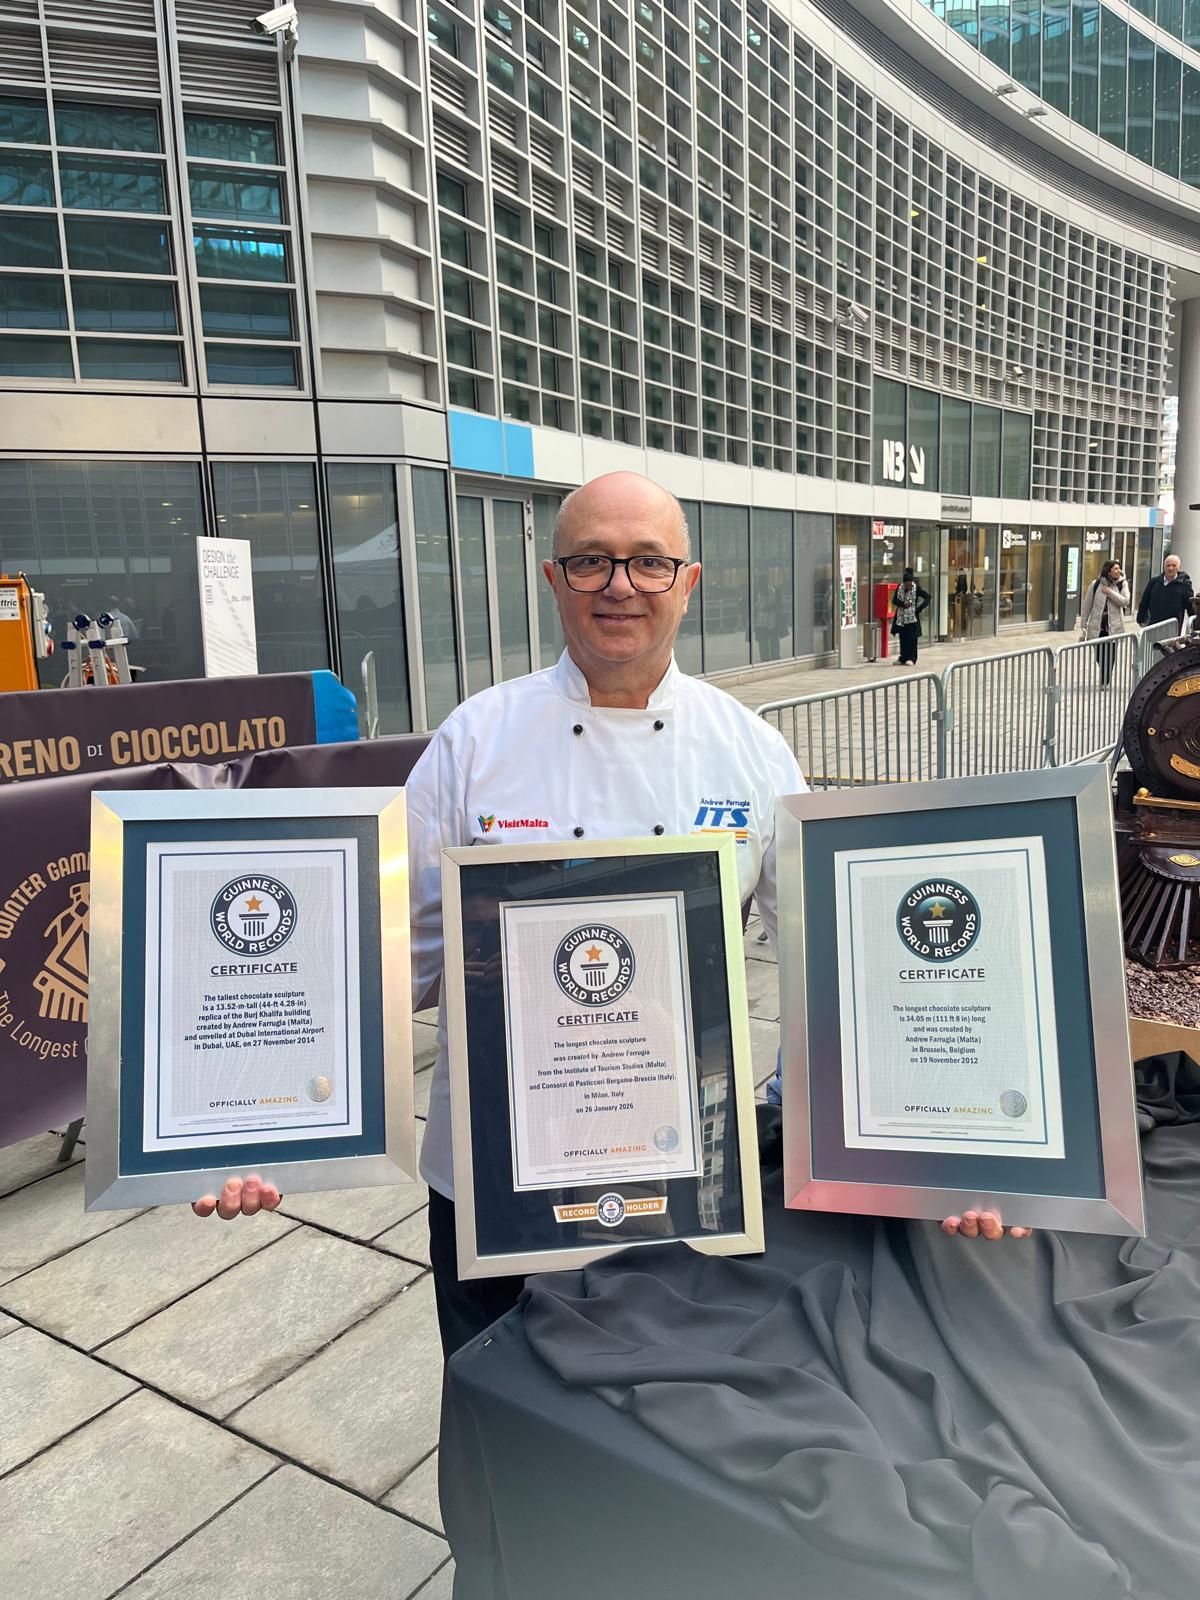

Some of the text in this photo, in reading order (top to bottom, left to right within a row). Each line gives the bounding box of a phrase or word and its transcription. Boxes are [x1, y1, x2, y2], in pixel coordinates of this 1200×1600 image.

[883, 439, 905, 482] N3
[203, 550, 226, 563] DESIGN
[204, 565, 240, 579] CHALLENGE
[87, 744, 103, 757] DI
[110, 715, 286, 765] CIOCCOLATO
[701, 798, 750, 807] Andrew Farrugia
[694, 806, 750, 827] ITS
[497, 819, 549, 829] VisitMalta
[46, 852, 91, 881] GAM
[223, 879, 286, 902] GUINNESS
[907, 883, 969, 907] GUINNESS
[215, 909, 292, 953] WORLD RECORDS
[901, 913, 976, 958] WORLD RECORDS
[564, 928, 623, 952] GUINNESS
[210, 962, 298, 975] CERTIFICATE
[899, 968, 985, 981] CERTIFICATE
[558, 957, 631, 1003] WORLD RECORDS
[217, 993, 239, 1001] tallest
[240, 992, 273, 1000] chocolate
[274, 991, 305, 1000] sculpture
[259, 1001, 279, 1009] (44-ft
[279, 999, 307, 1008] 4.28-in)
[905, 1005, 928, 1014] longest
[960, 1005, 991, 1014] sculpture
[198, 1013, 222, 1022] replica
[231, 1011, 243, 1019] the
[243, 1011, 258, 1020] Burj
[259, 1009, 283, 1018] Khalifa
[284, 1008, 311, 1017] building
[557, 1010, 639, 1025] CERTIFICATE
[906, 1015, 925, 1023] 34.05
[932, 1015, 948, 1024] (111
[961, 1015, 971, 1024] in)
[971, 1015, 986, 1025] long
[196, 1017, 313, 1031] created by Andrew Farrugia (Malta)
[913, 1025, 926, 1033] and
[939, 1025, 964, 1033] created
[964, 1025, 973, 1035] by
[10, 1020, 78, 1060] Longest
[184, 1026, 325, 1041] and unveiled at Dubai International Airport
[929, 1036, 956, 1045] Farrugia
[956, 1035, 982, 1044] (Malta)
[202, 1041, 224, 1050] Dubai,
[225, 1040, 242, 1049] UAE,
[252, 1039, 262, 1047] 27
[263, 1038, 296, 1046] November
[297, 1036, 315, 1045] 2014
[554, 1036, 647, 1049] The longest chocolate sculpture
[567, 1053, 590, 1061] created
[591, 1052, 599, 1062] by
[601, 1050, 625, 1059] Andrew
[625, 1049, 650, 1058] Farrugia
[919, 1046, 948, 1055] Brussels,
[949, 1046, 976, 1056] Belgium
[919, 1056, 928, 1064] 19
[928, 1056, 960, 1064] November
[961, 1056, 979, 1064] 2012
[553, 1067, 563, 1075] the
[564, 1066, 589, 1075] Institute
[590, 1065, 597, 1073] of
[597, 1063, 621, 1072] Tourism
[645, 1060, 667, 1070] (Malta)
[529, 1082, 541, 1091] and
[568, 1079, 575, 1088] di
[575, 1077, 605, 1087] Pasticceri
[606, 1074, 657, 1086] Bergamo-Brescia
[584, 1092, 591, 1100] in
[611, 1089, 625, 1099] Italy
[209, 1096, 299, 1108] OFFICIALLY AMAZING
[585, 1105, 593, 1113] 26
[593, 1104, 618, 1113] January
[619, 1102, 634, 1111] 2026
[904, 1105, 993, 1115] OFFICIALLY AMAZING
[563, 1145, 647, 1158] OFFICIALLY AMAZING
[562, 1202, 659, 1217] RECORD HOLDER
